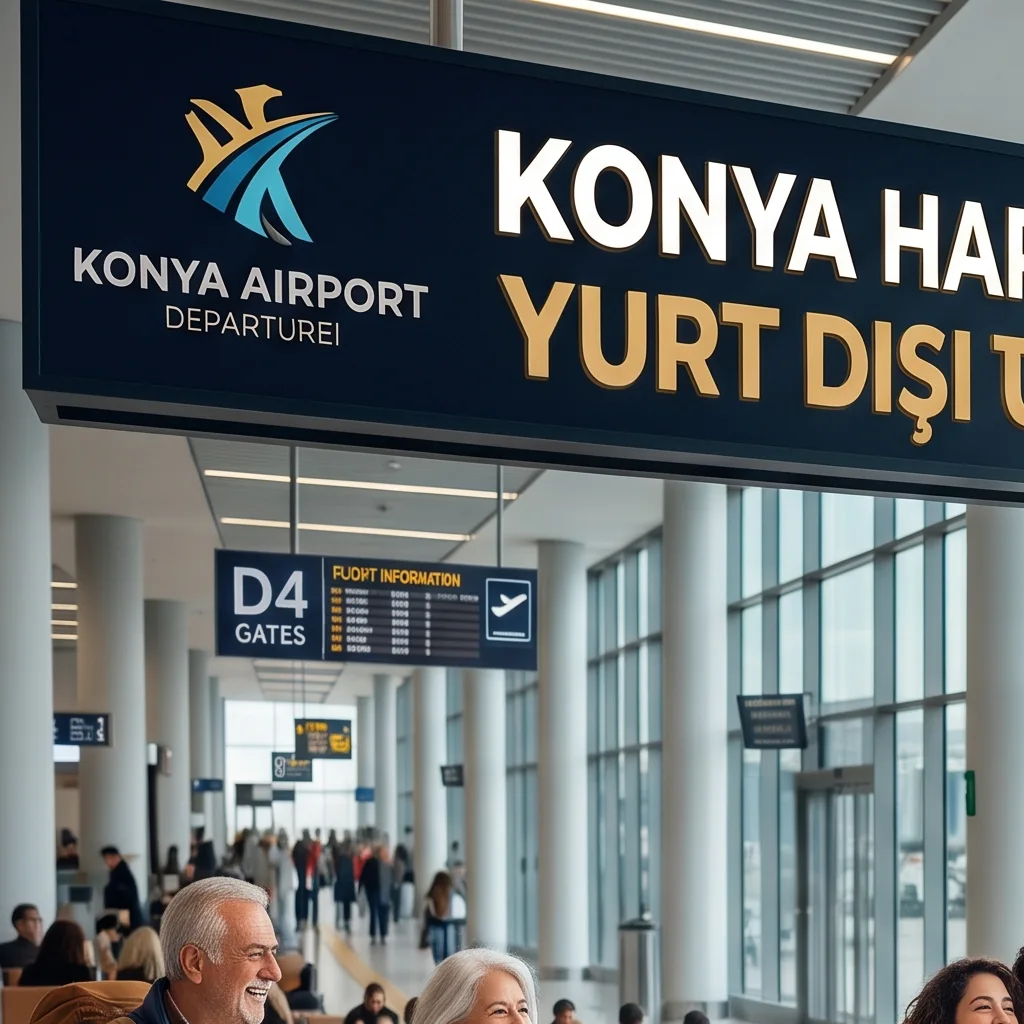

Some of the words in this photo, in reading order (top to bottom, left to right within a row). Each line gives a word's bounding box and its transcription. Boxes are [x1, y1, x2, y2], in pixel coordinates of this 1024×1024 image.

[496, 128, 857, 280] KONYA
[74, 246, 230, 298] KONYA
[240, 265, 429, 319] AIRPORT
[165, 304, 340, 346] DEPARTUREI
[498, 273, 780, 400] YURT
[804, 310, 971, 445] DIŞI
[233, 566, 308, 619] D4
[380, 568, 461, 587] INFORMATION
[235, 622, 306, 646] GATES
